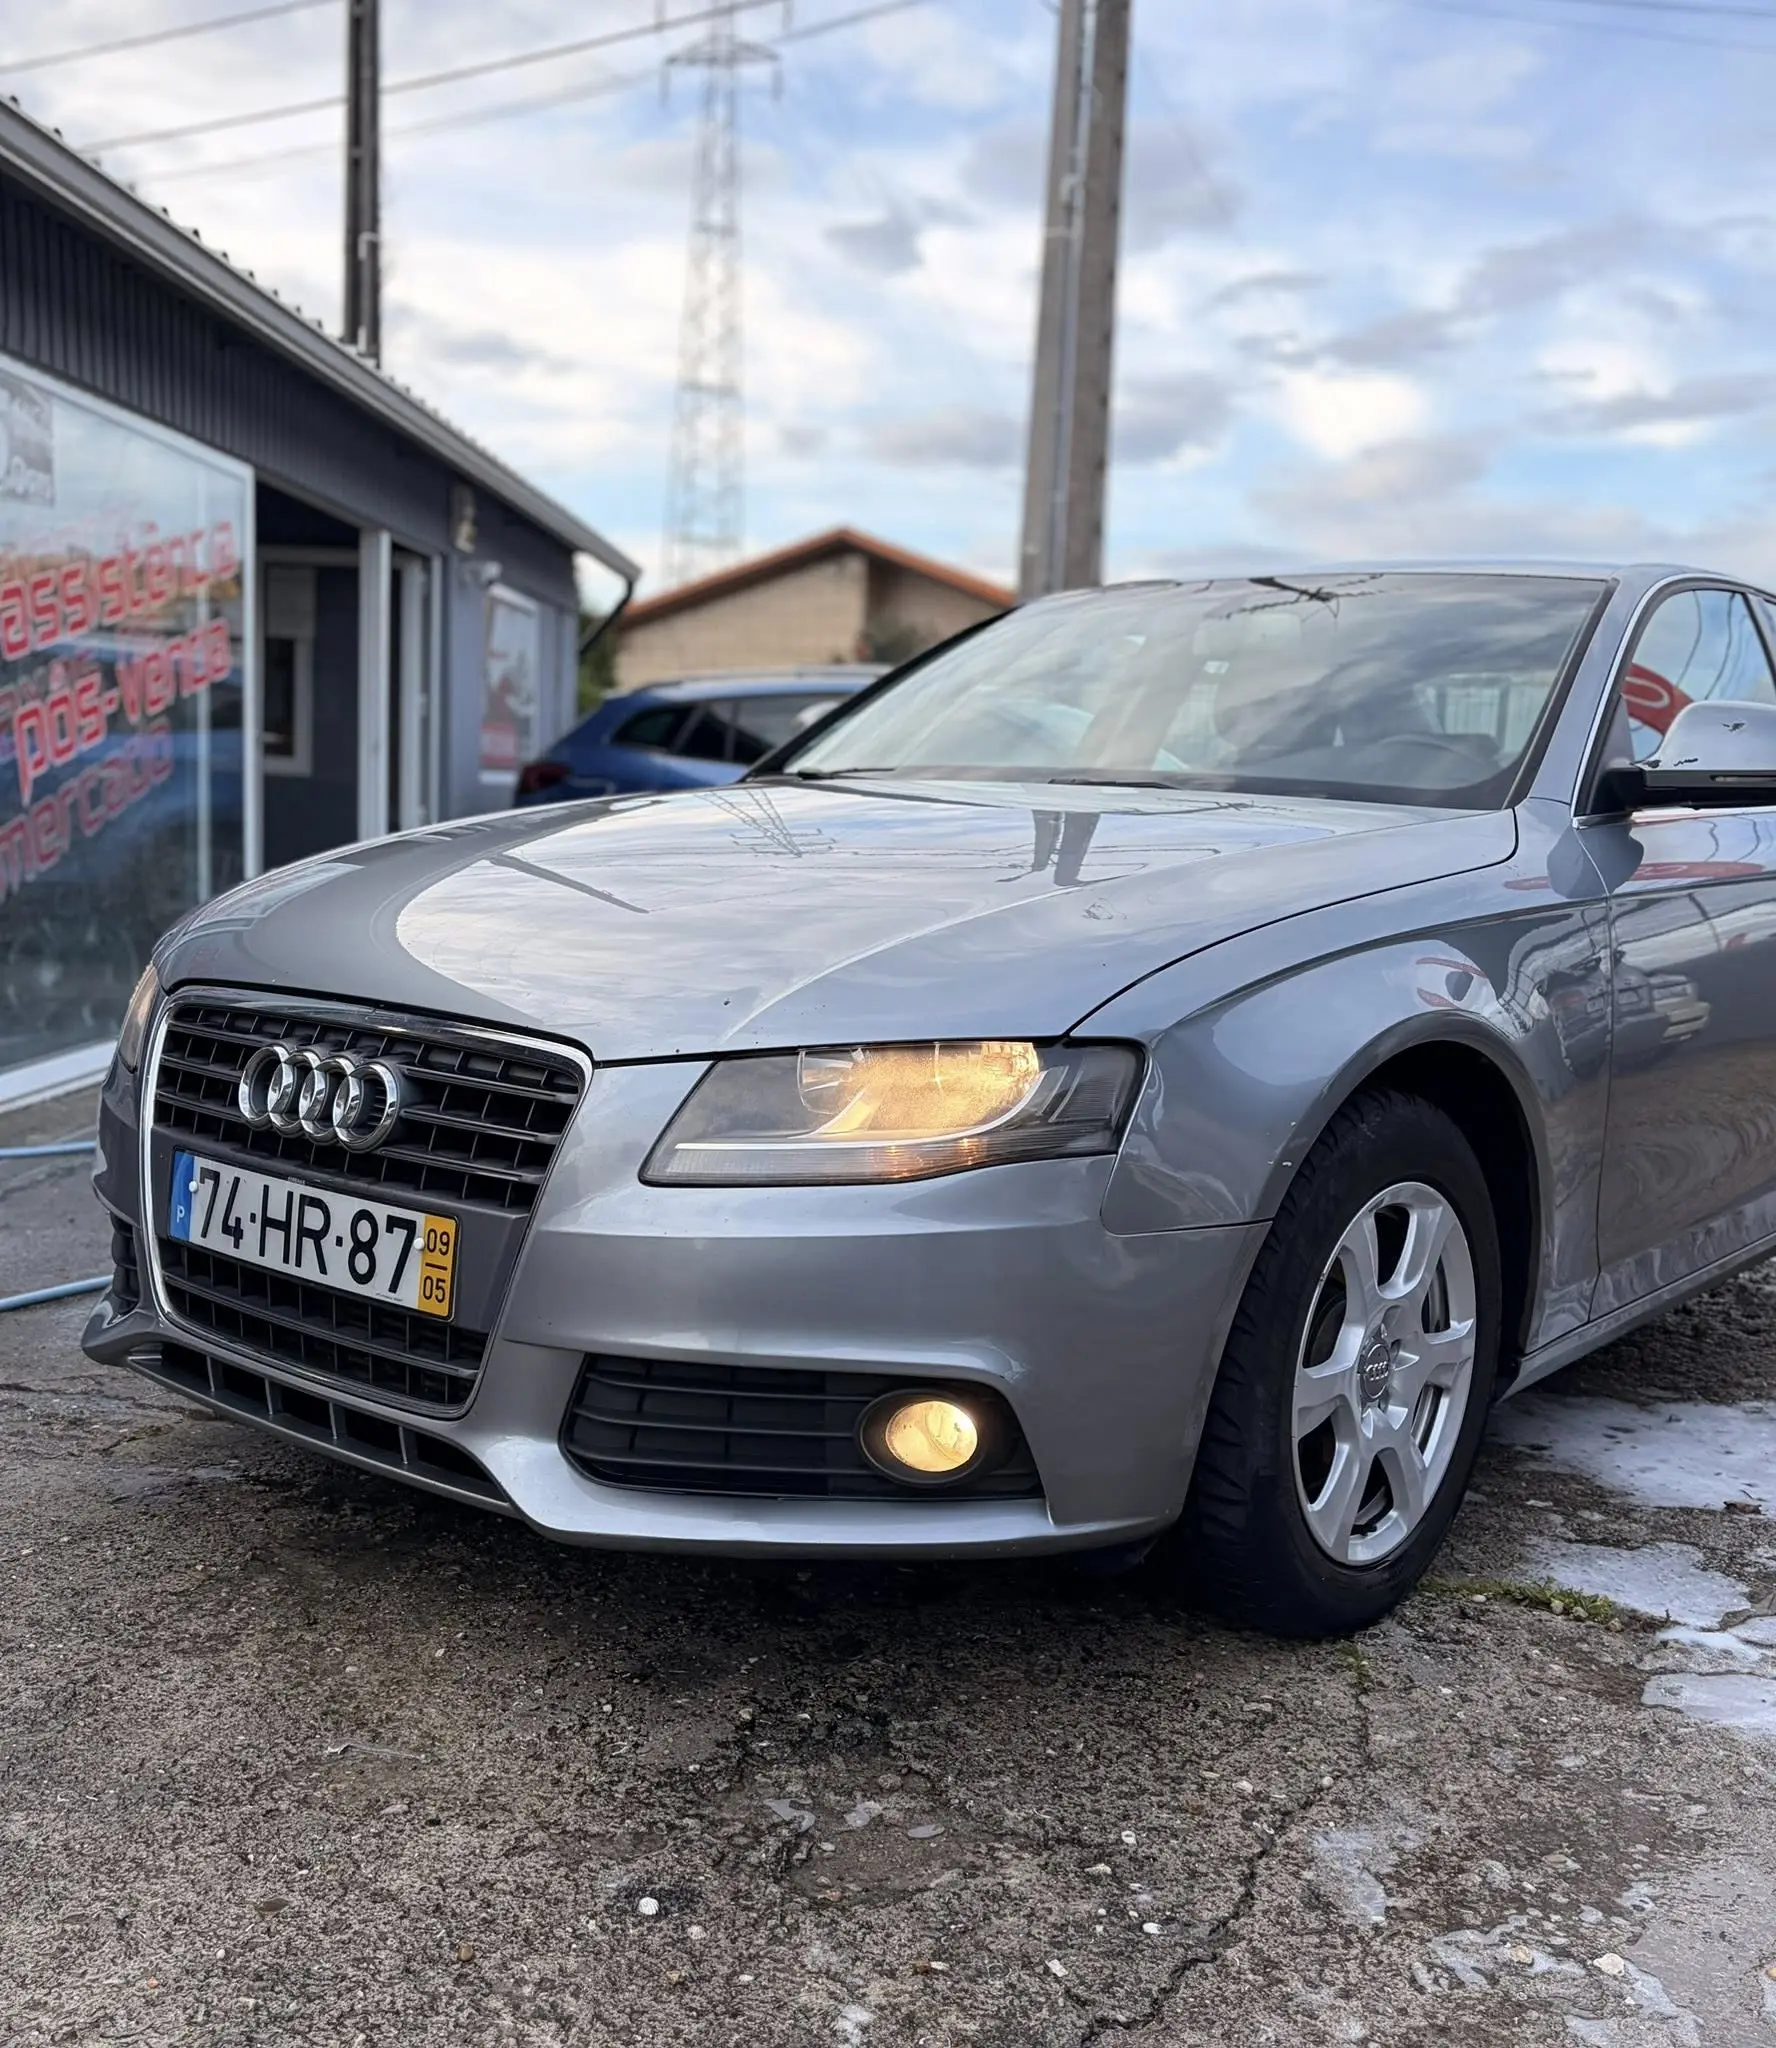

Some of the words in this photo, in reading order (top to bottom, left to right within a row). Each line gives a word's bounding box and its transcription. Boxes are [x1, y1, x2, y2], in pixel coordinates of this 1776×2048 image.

[176, 1205, 185, 1223] P
[426, 1228, 450, 1256] 09
[422, 1275, 446, 1303] 05
